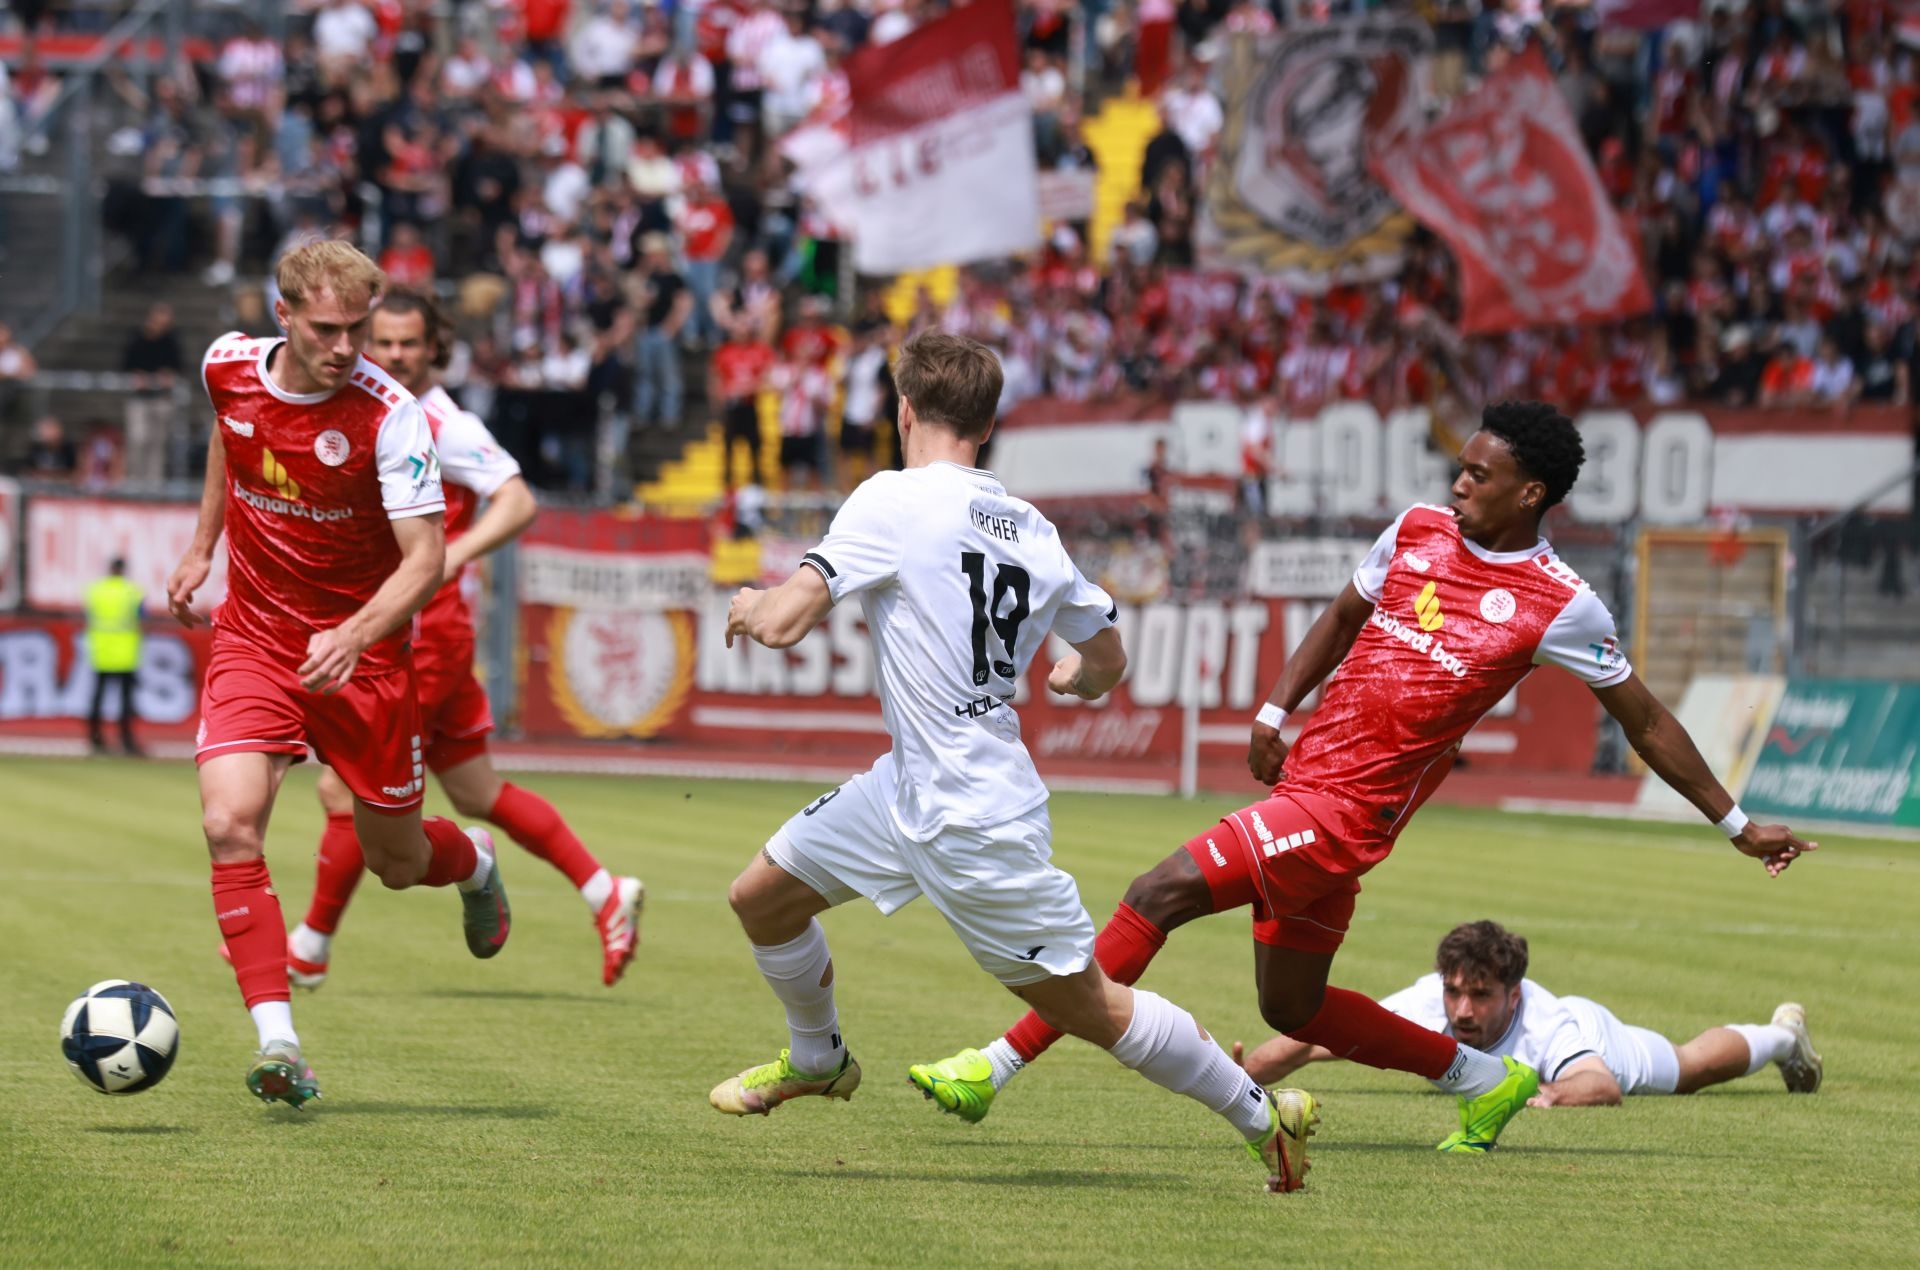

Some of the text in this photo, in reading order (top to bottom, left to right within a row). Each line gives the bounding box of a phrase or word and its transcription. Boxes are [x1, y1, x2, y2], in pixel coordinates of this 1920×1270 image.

[1568, 408, 1716, 528] 30
[311, 505, 354, 522] bau
[969, 505, 1020, 543] KIRCHER
[960, 551, 1031, 687] 19
[1430, 640, 1468, 677] bau
